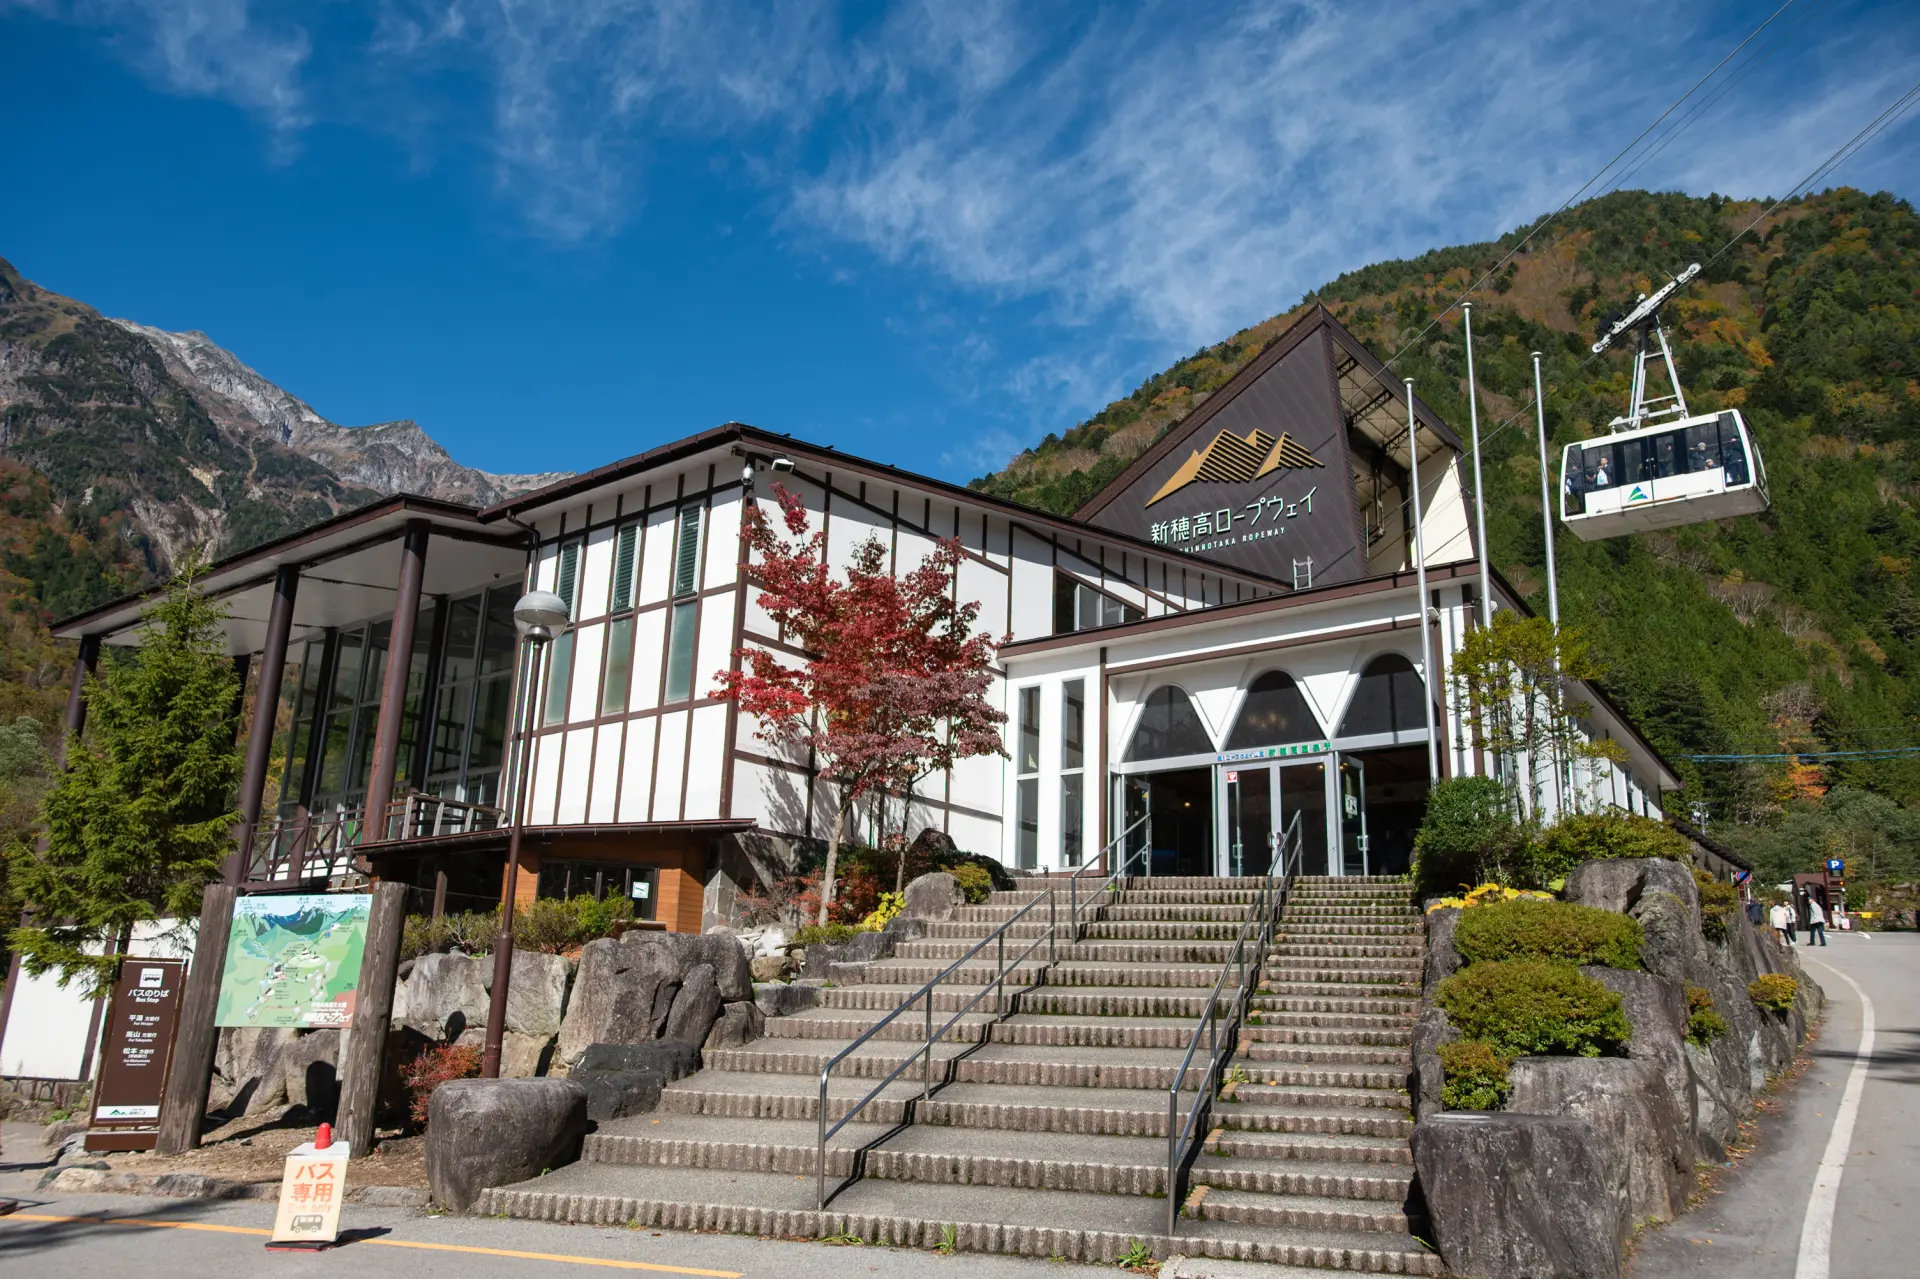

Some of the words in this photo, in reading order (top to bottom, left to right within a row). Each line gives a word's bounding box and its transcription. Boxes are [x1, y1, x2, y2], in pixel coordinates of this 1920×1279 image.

[1151, 486, 1317, 545] 新穂高ロープウェイ
[1180, 538, 1236, 554] HINHOTAKA
[1242, 526, 1286, 543] ROPEWAY
[1831, 861, 1839, 869] P
[127, 989, 170, 998] バスのりば
[295, 1163, 335, 1180] バス
[290, 1183, 333, 1203] 専用
[311, 1201, 332, 1214] only
